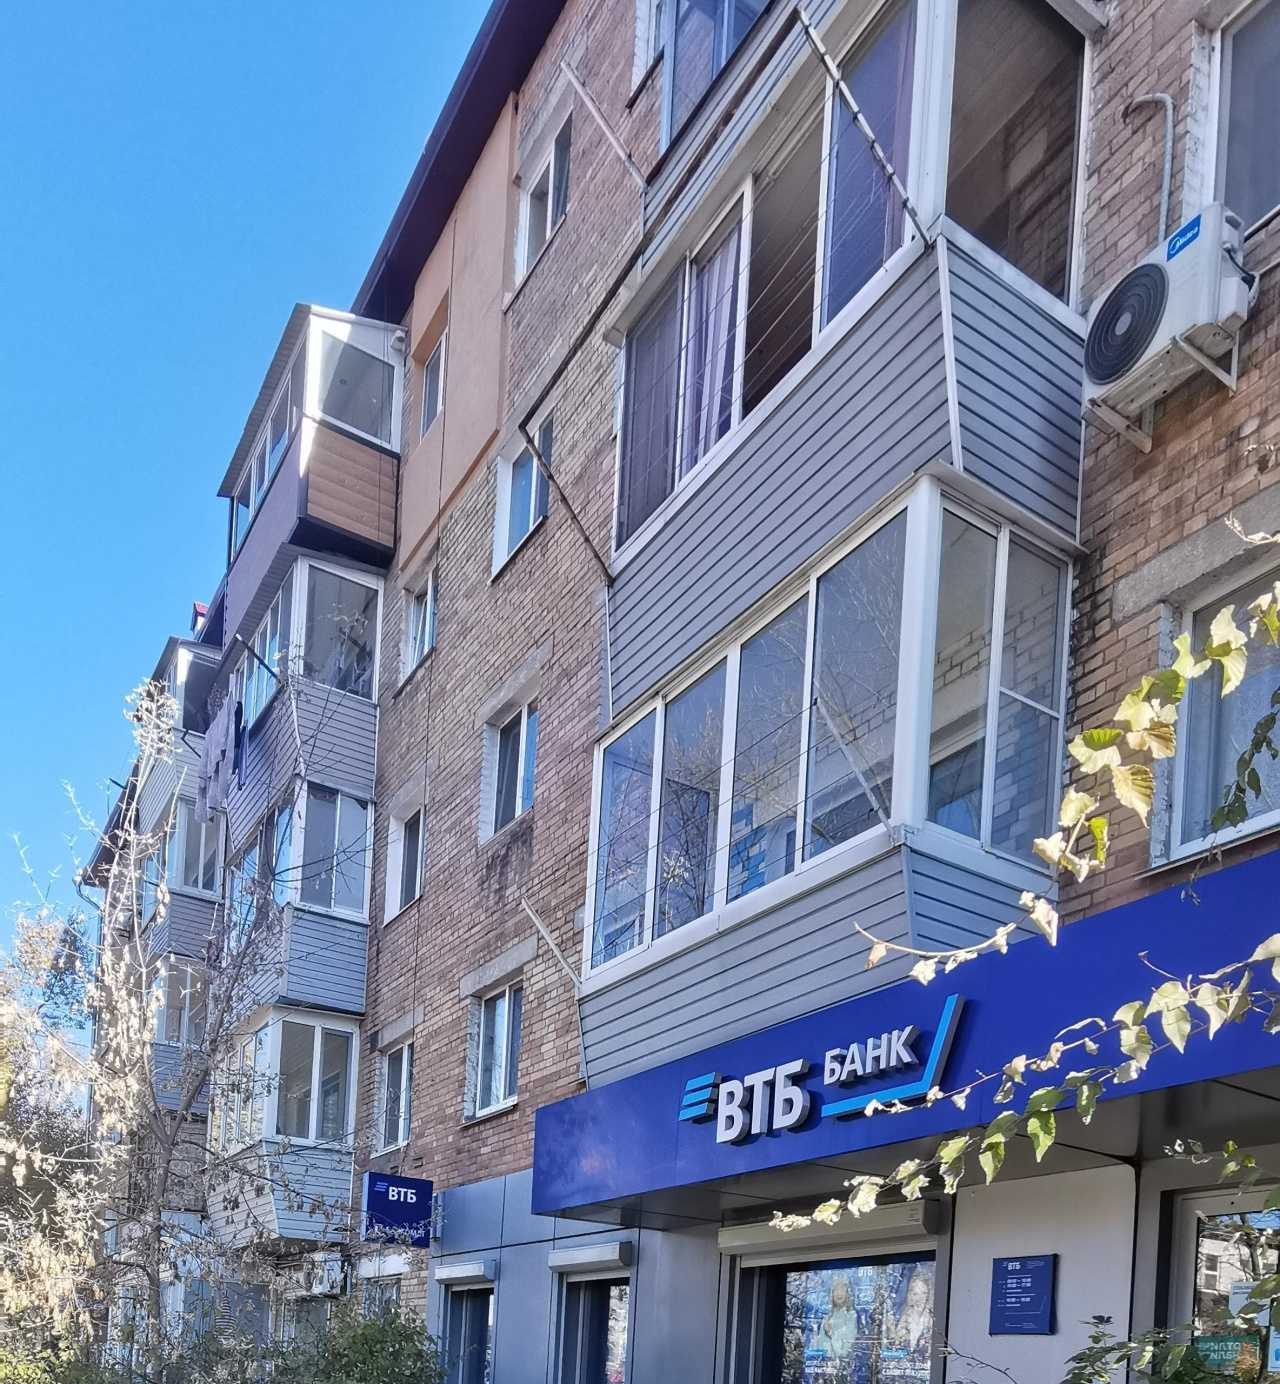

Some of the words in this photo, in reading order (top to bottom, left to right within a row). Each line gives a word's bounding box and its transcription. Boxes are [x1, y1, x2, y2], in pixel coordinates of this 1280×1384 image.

[716, 1058, 808, 1144] ВТБ
[824, 1025, 917, 1085] БАНК
[388, 1186, 417, 1203] ВТБ
